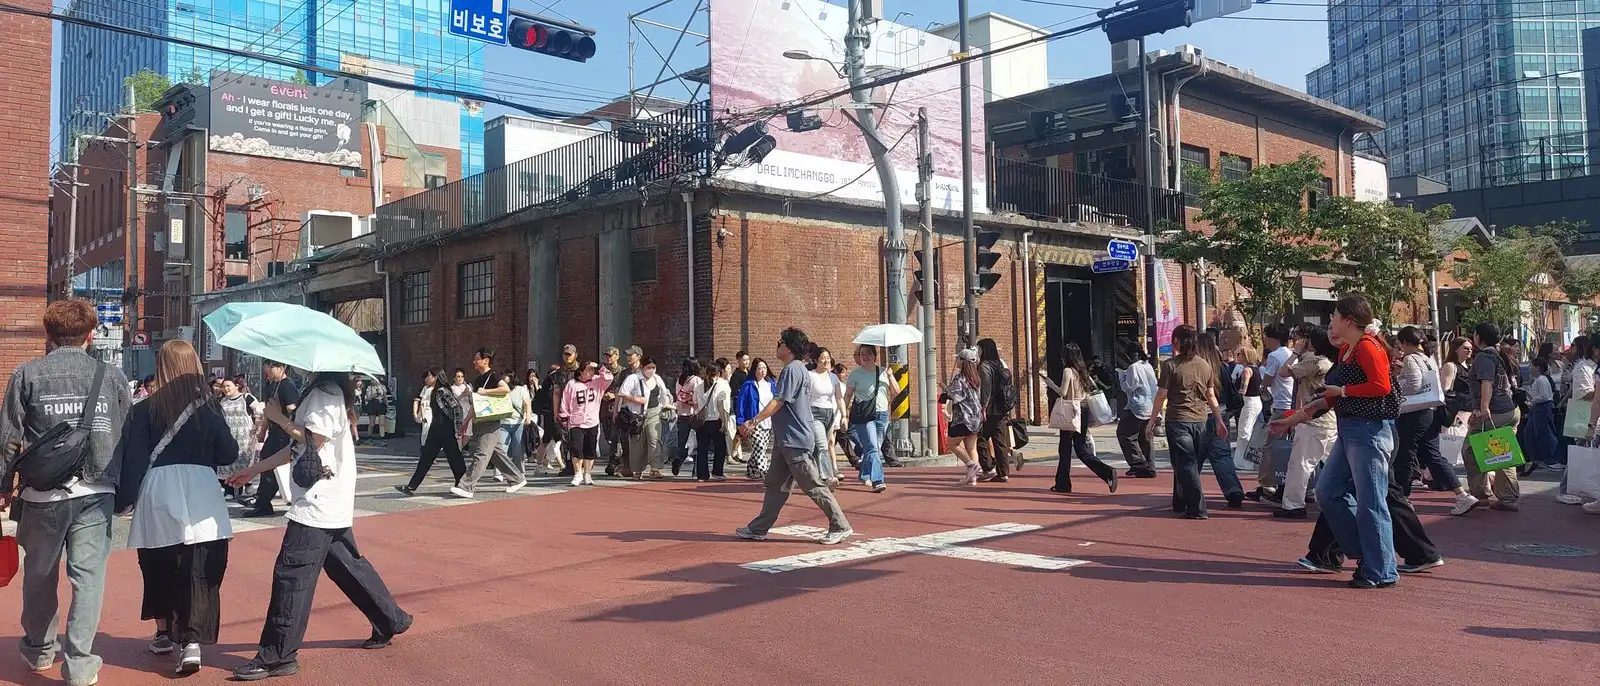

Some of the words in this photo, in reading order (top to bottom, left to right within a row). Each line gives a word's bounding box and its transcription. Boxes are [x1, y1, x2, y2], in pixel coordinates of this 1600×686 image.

[453, 9, 504, 39] 비보호
[270, 84, 308, 99] event
[221, 92, 235, 102] Ah
[247, 98, 270, 107] wear
[271, 99, 299, 111] florals
[299, 104, 316, 114] just
[317, 109, 334, 117] one
[335, 109, 352, 121] day,
[226, 103, 244, 114] and
[250, 108, 266, 118] get
[267, 110, 273, 118] a
[274, 109, 292, 121] gift!
[293, 112, 320, 125] Lucky
[321, 117, 337, 127] me.
[253, 119, 271, 127] you're
[271, 121, 295, 131] wearing
[253, 125, 271, 133] Come
[289, 130, 299, 138] get
[44, 402, 108, 415] RUNHRD
